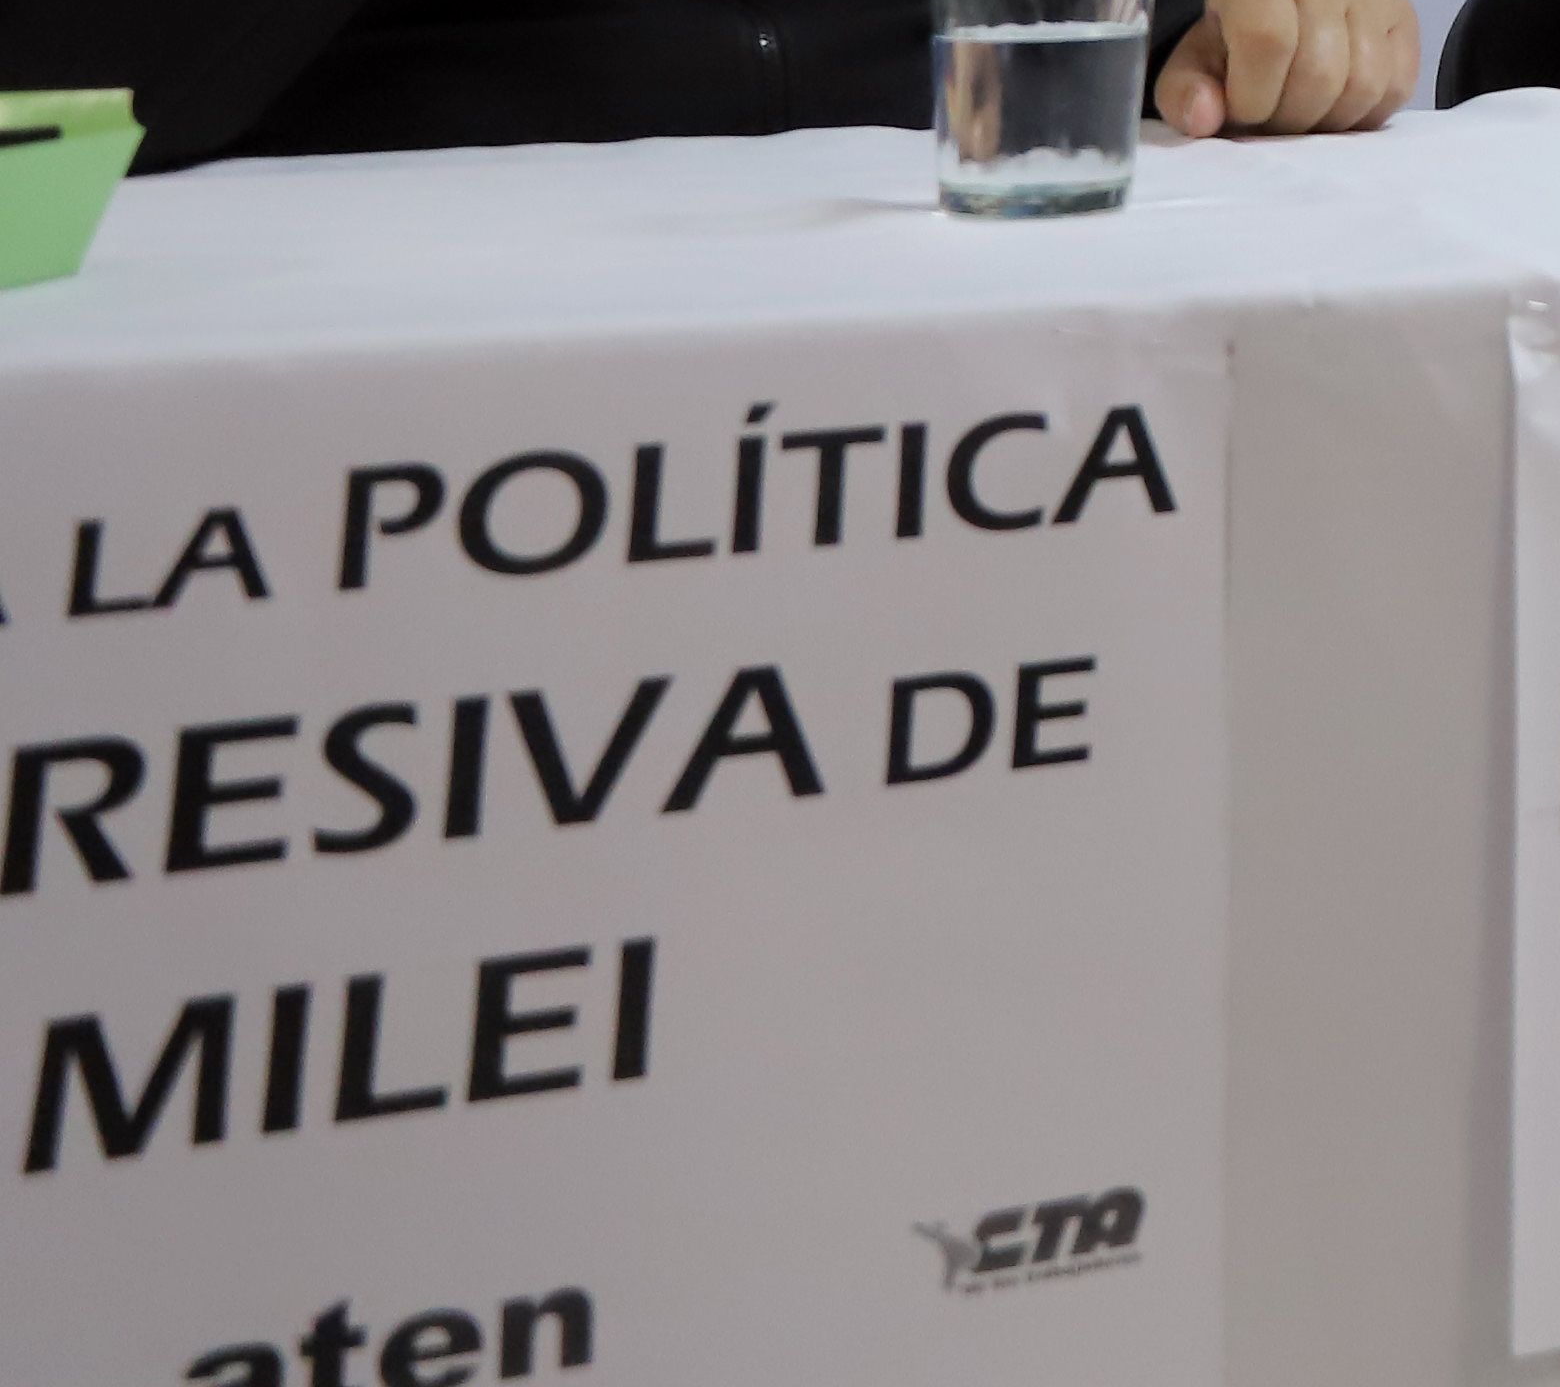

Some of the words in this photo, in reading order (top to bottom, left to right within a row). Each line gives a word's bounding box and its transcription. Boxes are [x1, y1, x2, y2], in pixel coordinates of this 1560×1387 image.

[66, 507, 272, 618] LA
[337, 401, 1178, 591] POLÍTICA
[884, 656, 1097, 787] DE
[22, 935, 657, 1176] MILEI
